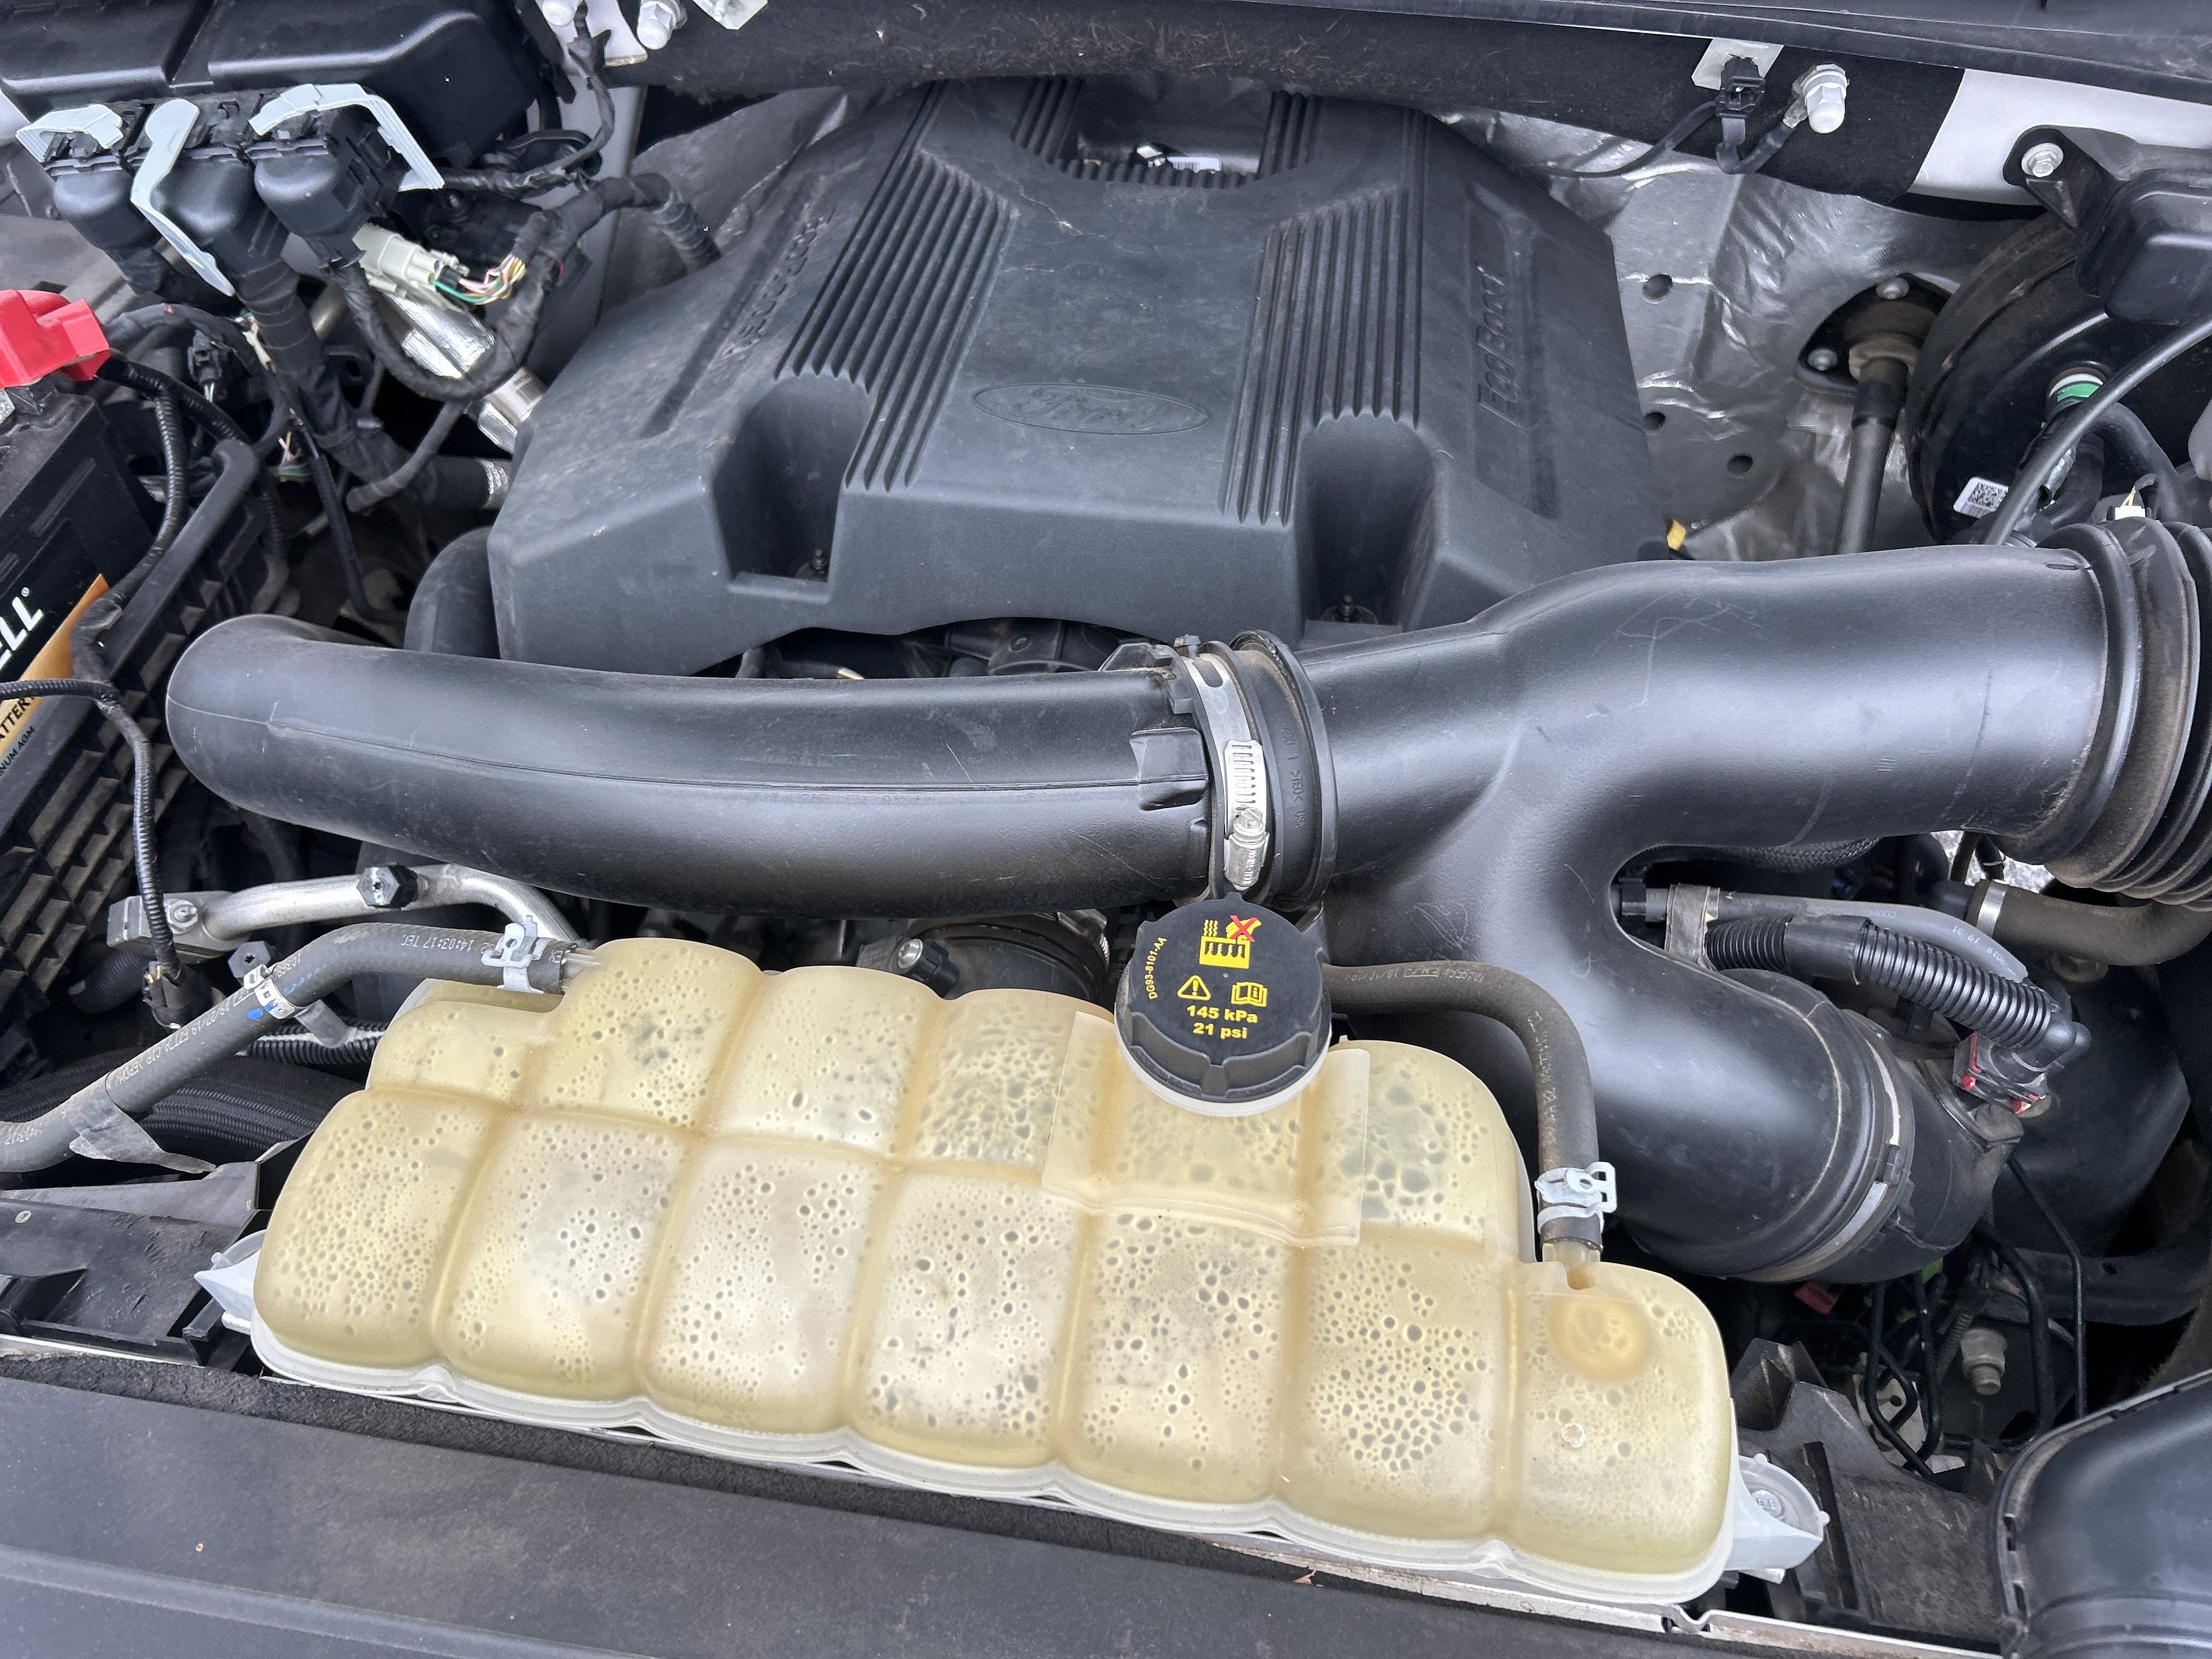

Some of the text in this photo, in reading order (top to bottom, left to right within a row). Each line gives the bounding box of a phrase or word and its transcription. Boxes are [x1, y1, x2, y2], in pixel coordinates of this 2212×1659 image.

[1012, 388, 1166, 426] Ford
[0, 697, 35, 739] TTER
[0, 748, 18, 776] NUM
[1144, 936, 1167, 1000] DG93-8101-AA
[1187, 1005, 1258, 1024] 145 kPa
[1193, 1022, 1248, 1040] 21 psi
